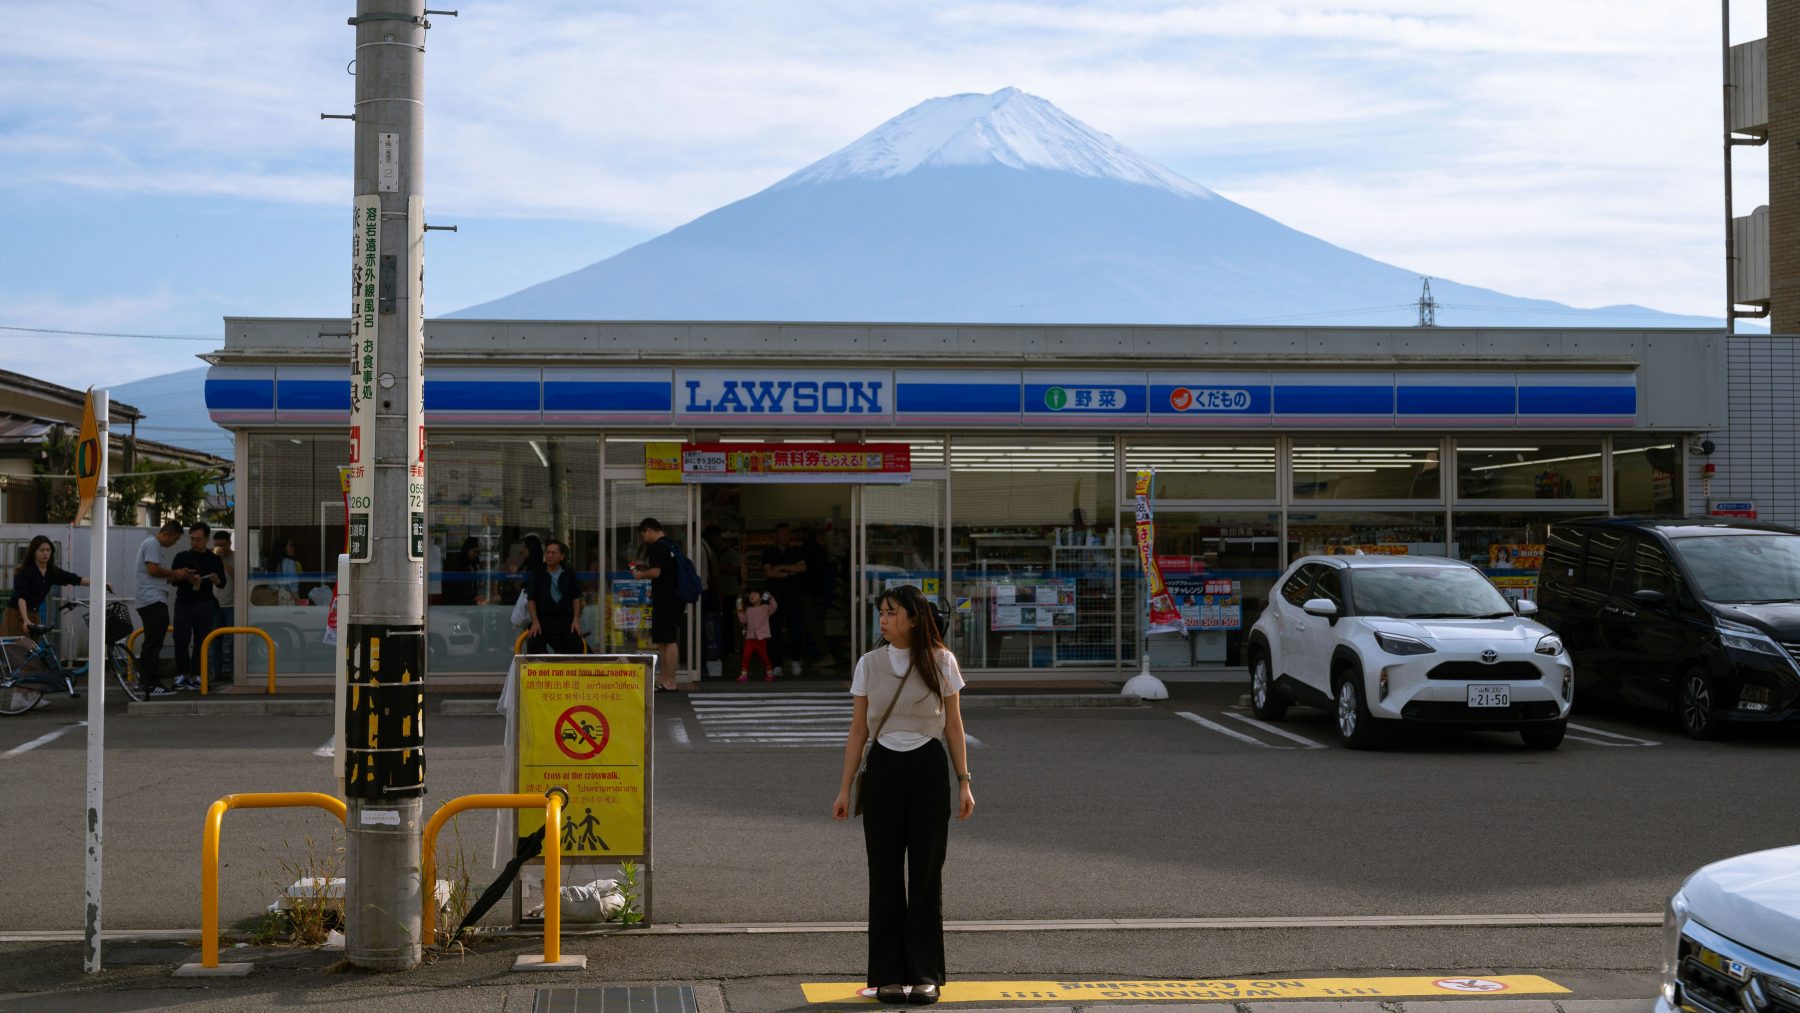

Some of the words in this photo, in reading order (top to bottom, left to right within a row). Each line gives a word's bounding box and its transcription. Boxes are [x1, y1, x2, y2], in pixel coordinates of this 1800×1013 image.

[364, 206, 377, 328] 溶岩遠赤外線風呂
[362, 339, 374, 400] お食事処
[685, 380, 882, 413] LAWSON
[1075, 390, 1116, 408] 野菜
[1194, 391, 1247, 408] くだもの
[528, 669, 537, 677] Do
[539, 669, 549, 677] not
[552, 669, 563, 677] run
[566, 669, 576, 677] out
[579, 669, 592, 677] into
[595, 669, 605, 677] the
[608, 669, 638, 678] roadway.
[1478, 694, 1507, 705] 21-50
[544, 771, 561, 780] Cross
[563, 771, 570, 780] at
[572, 771, 582, 780] the
[584, 771, 620, 780] crosswalk.
[1056, 981, 1237, 991] Crossing
[1250, 981, 1306, 989] NO
[1101, 989, 1281, 998] WARNING
